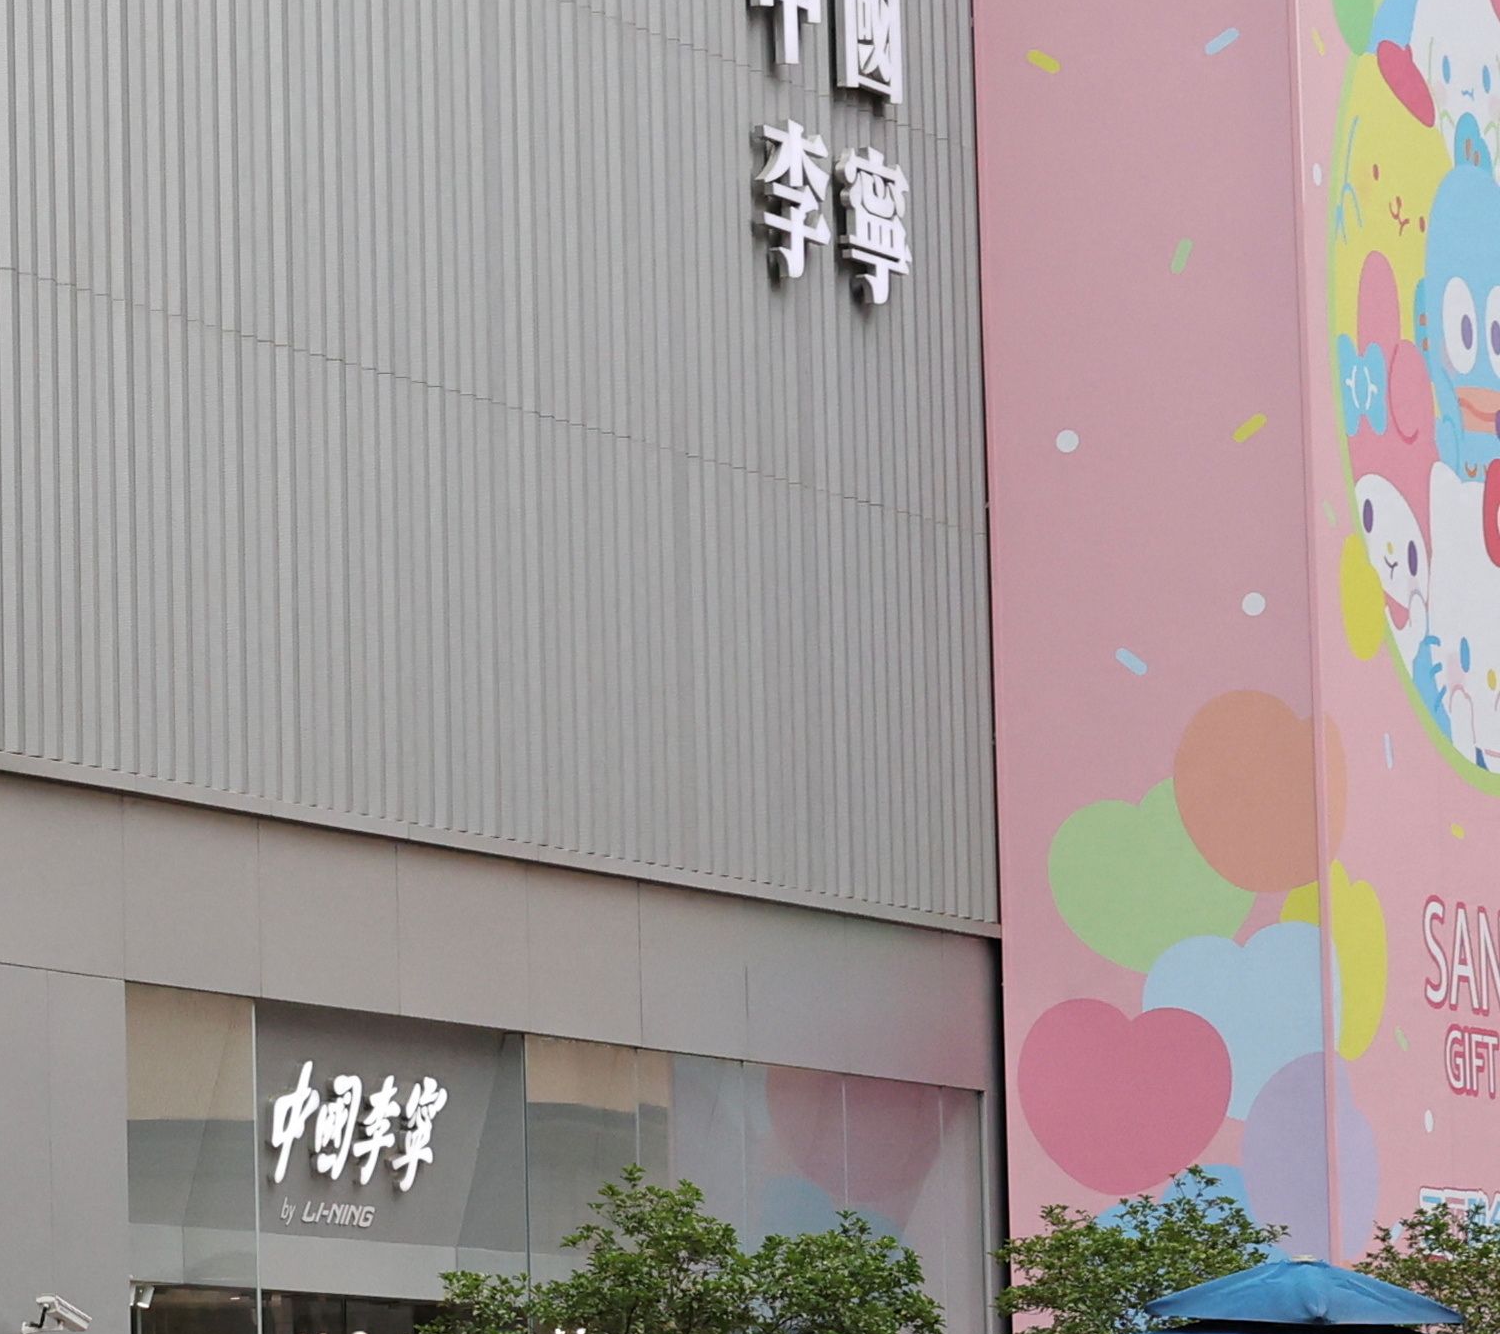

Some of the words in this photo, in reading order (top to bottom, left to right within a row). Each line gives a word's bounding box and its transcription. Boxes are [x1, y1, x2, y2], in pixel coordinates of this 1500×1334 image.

[1444, 1024, 1500, 1099] GIFT
[281, 1197, 296, 1226] by
[301, 1200, 376, 1229] LI-NING
